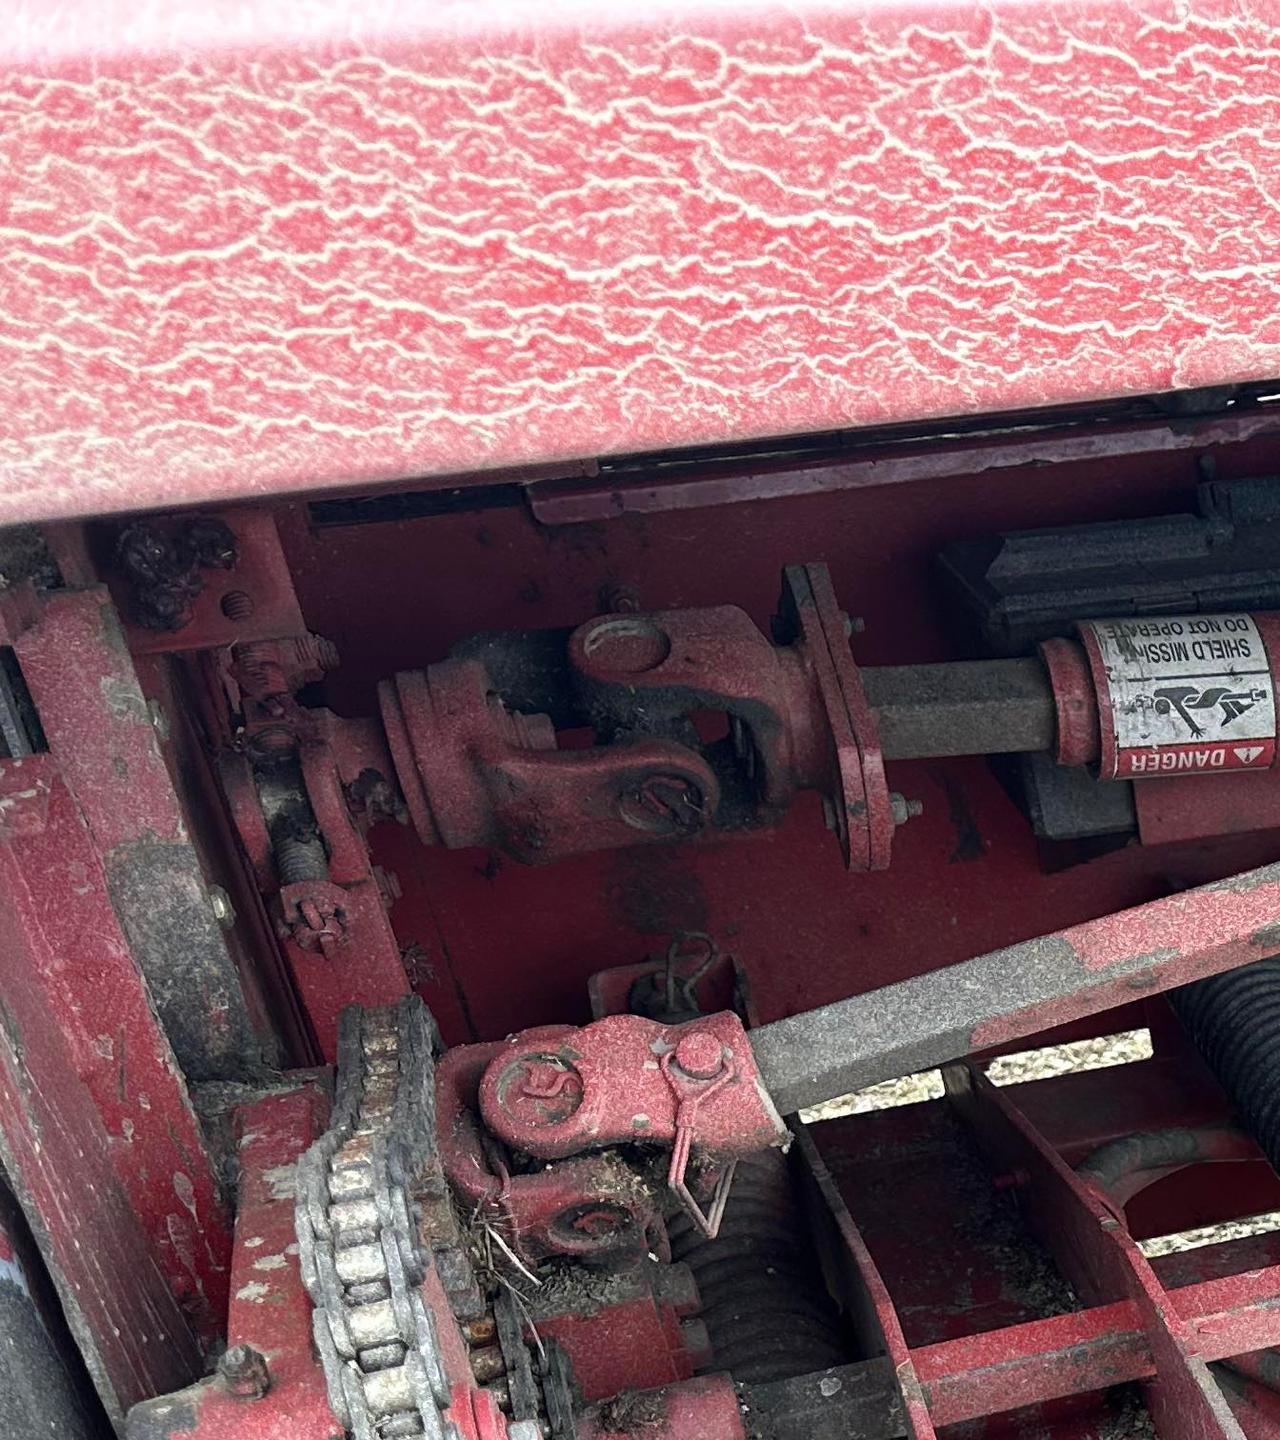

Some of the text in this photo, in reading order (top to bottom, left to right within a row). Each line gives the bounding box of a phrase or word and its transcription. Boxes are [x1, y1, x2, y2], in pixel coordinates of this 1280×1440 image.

[1102, 618, 1250, 640] DO NOT OPERATE
[1192, 638, 1251, 659] SHIELD
[1131, 749, 1226, 772] DANGER
